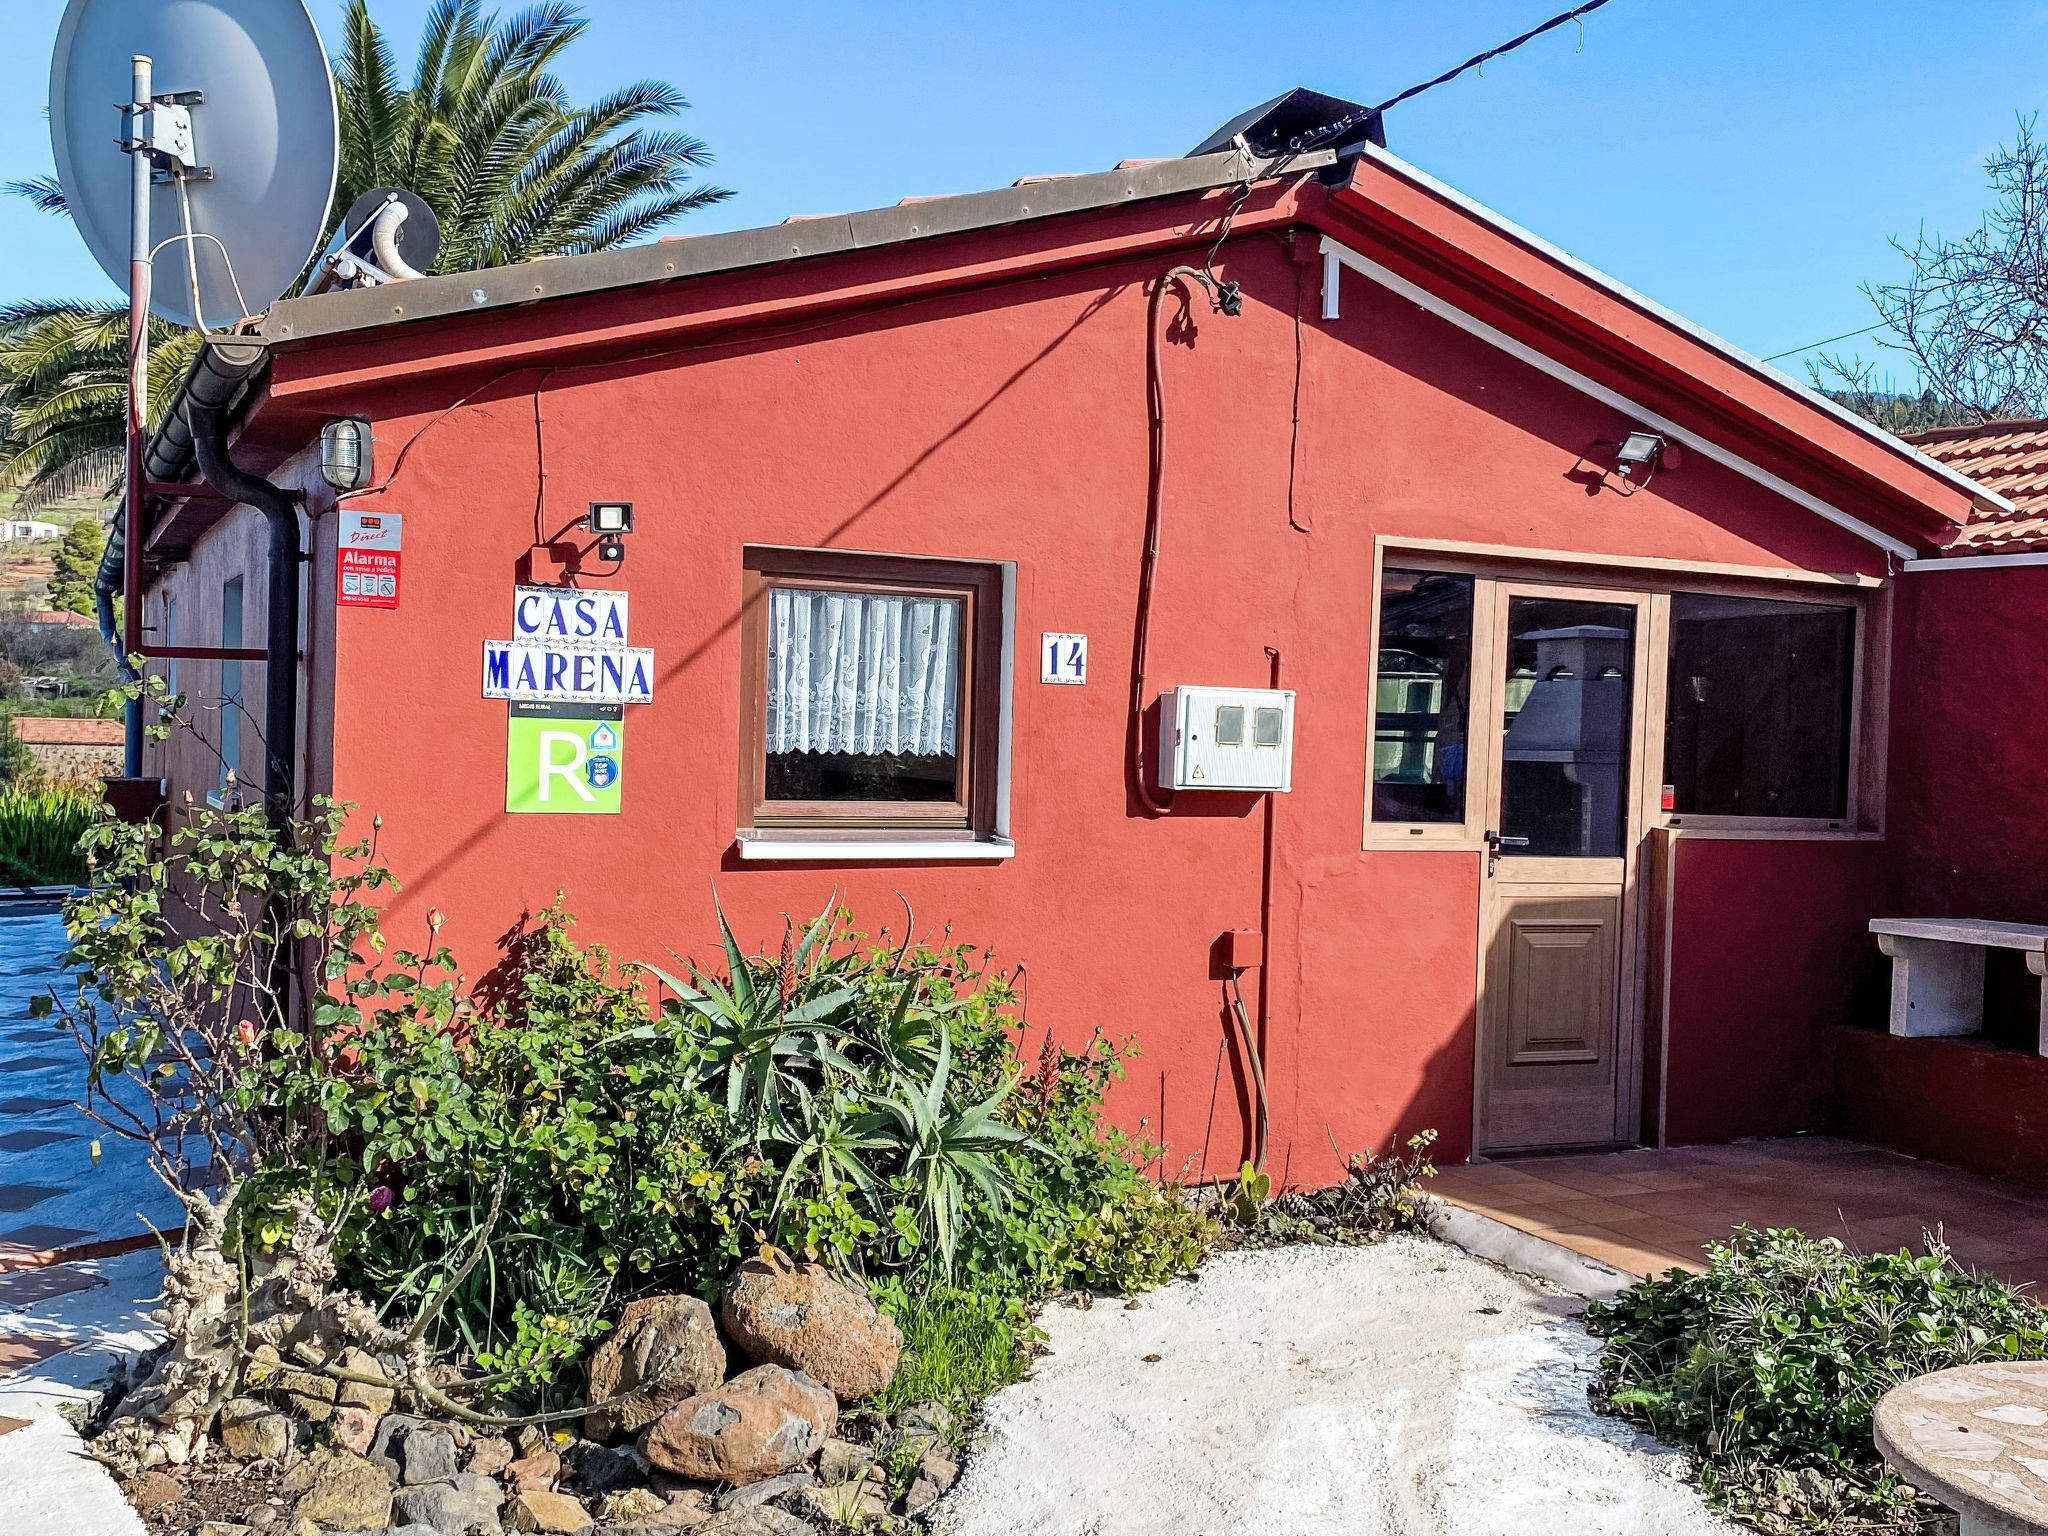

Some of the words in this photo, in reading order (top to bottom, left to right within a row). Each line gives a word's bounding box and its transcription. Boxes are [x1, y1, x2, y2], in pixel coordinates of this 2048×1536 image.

[350, 529, 388, 543] Direct
[343, 551, 396, 566] Alarma
[517, 595, 624, 638] CASA
[486, 649, 650, 695] MARENA
[1049, 641, 1084, 676] 14
[538, 730, 597, 802] R
